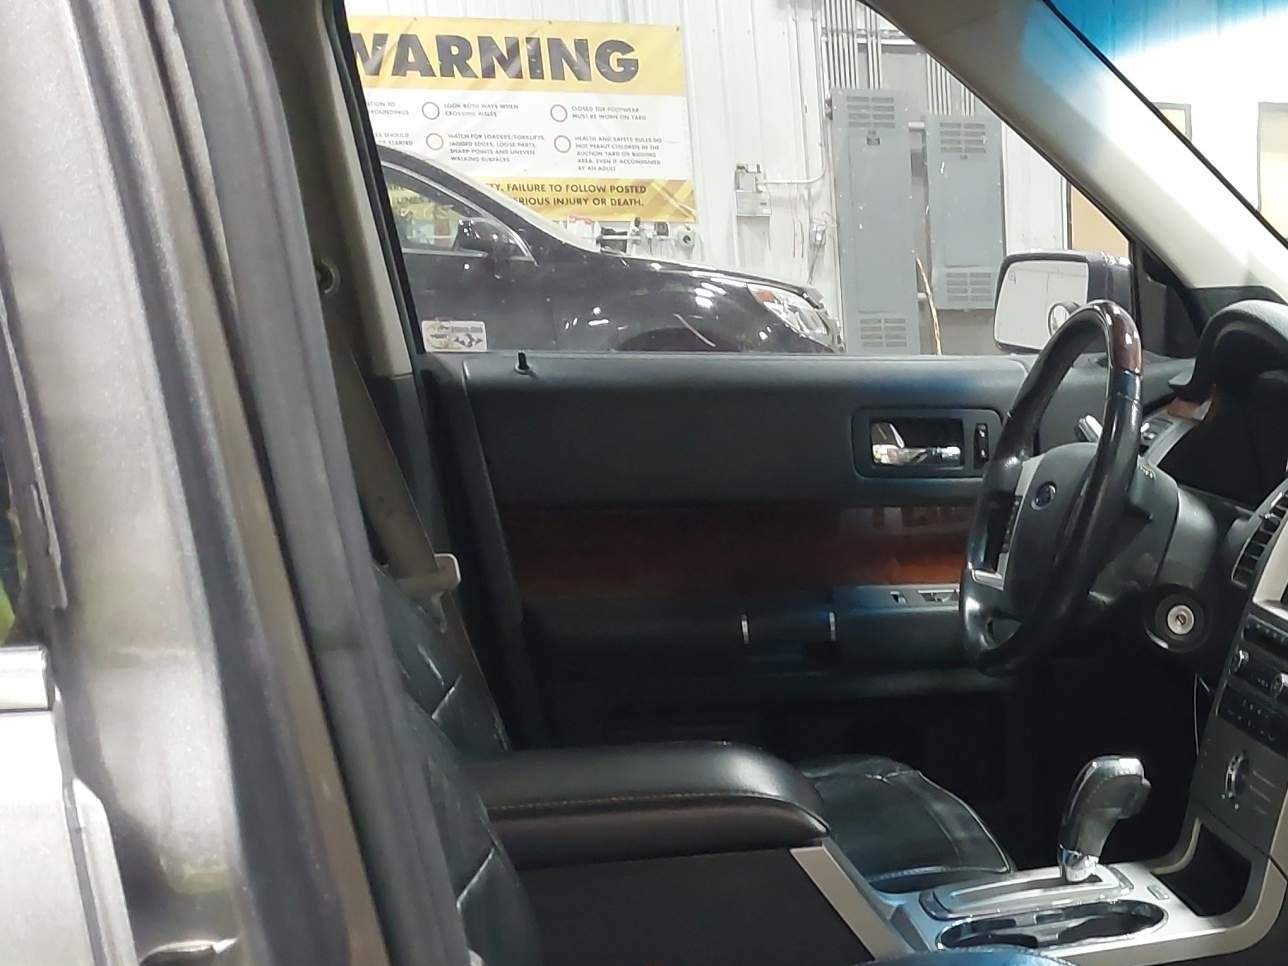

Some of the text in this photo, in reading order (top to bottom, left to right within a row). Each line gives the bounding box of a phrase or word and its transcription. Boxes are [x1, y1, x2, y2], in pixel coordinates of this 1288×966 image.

[507, 184, 546, 192] FAILURE
[549, 184, 562, 192] TO
[566, 184, 606, 193] FOLLOW
[610, 184, 647, 193] POSTED
[514, 197, 550, 206] RIOUS
[553, 197, 588, 206] INJURY
[592, 198, 607, 206] OR
